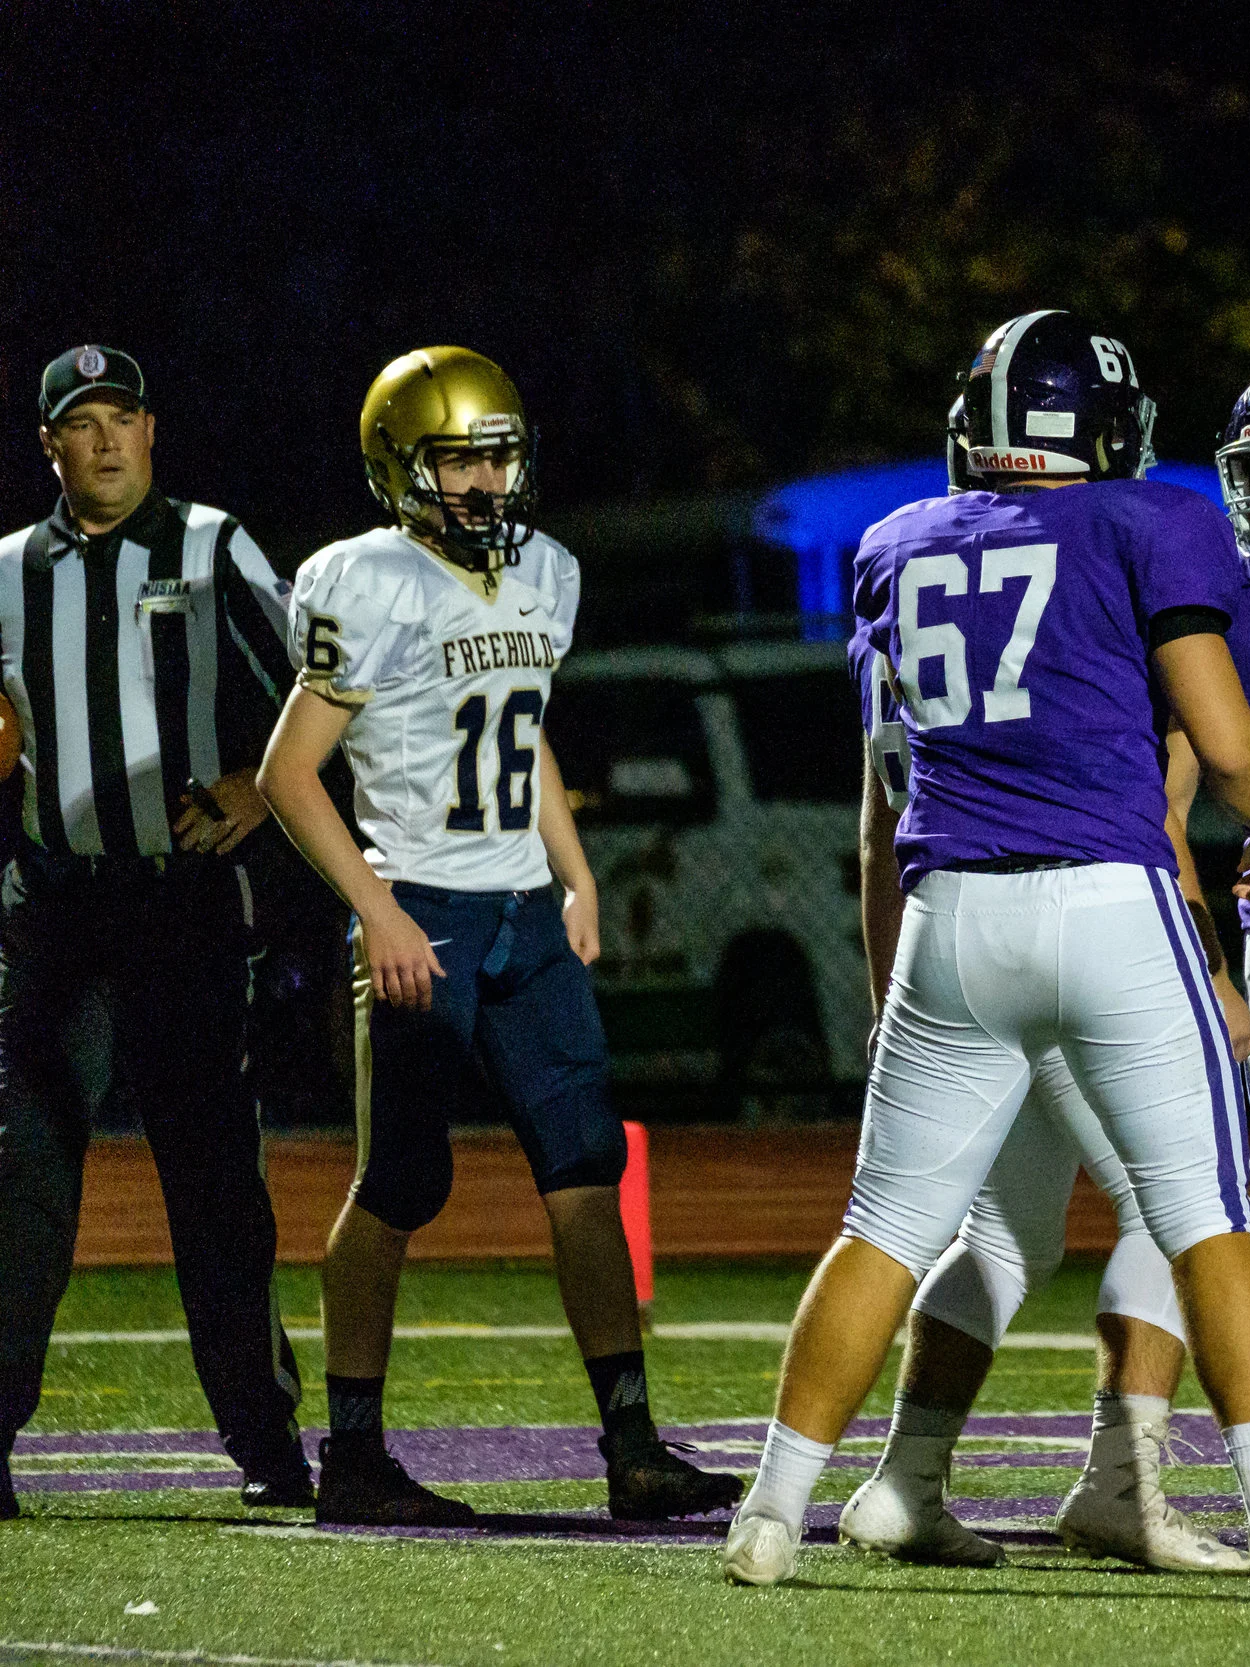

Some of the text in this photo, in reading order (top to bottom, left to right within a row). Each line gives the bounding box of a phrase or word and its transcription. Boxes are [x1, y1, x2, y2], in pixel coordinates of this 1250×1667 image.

[1090, 336, 1139, 389] 67
[973, 453, 1046, 471] Riddell
[442, 630, 554, 678] FREEHOLD
[898, 543, 1058, 730] 67
[444, 686, 544, 834] 16
